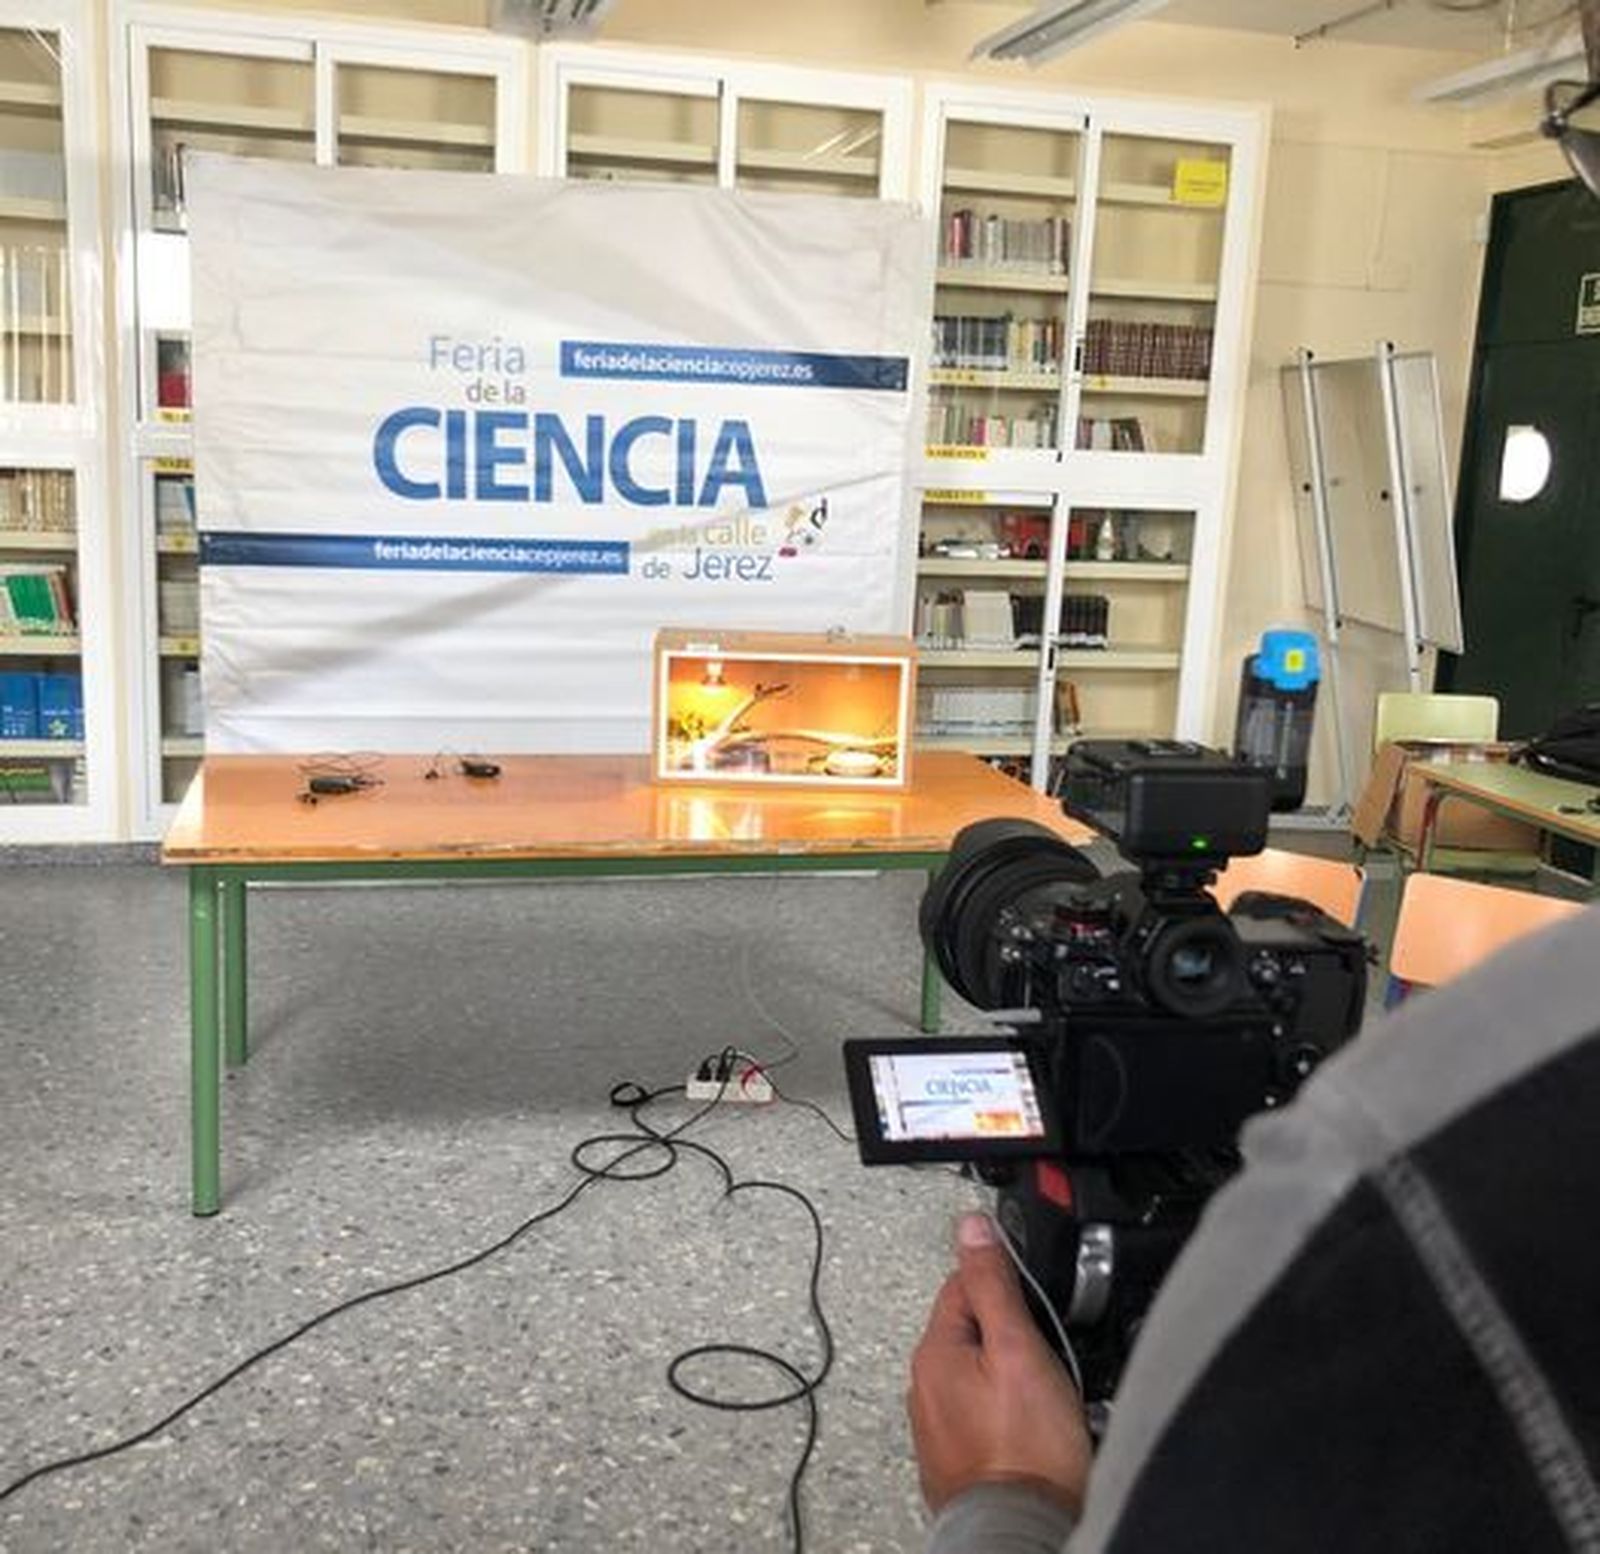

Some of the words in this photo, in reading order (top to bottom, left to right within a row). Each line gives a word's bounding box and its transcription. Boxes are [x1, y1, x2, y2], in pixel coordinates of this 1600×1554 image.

[429, 335, 526, 375] Feria
[573, 349, 814, 382] feriadelacienciacepjerez.es
[465, 377, 499, 403] de
[504, 379, 526, 405] la
[373, 406, 768, 508] CIENCIA
[704, 514, 768, 545] calle
[374, 540, 623, 567] feriadelacienciacepjerez.es
[641, 555, 672, 580] de
[682, 546, 774, 582] Jerez
